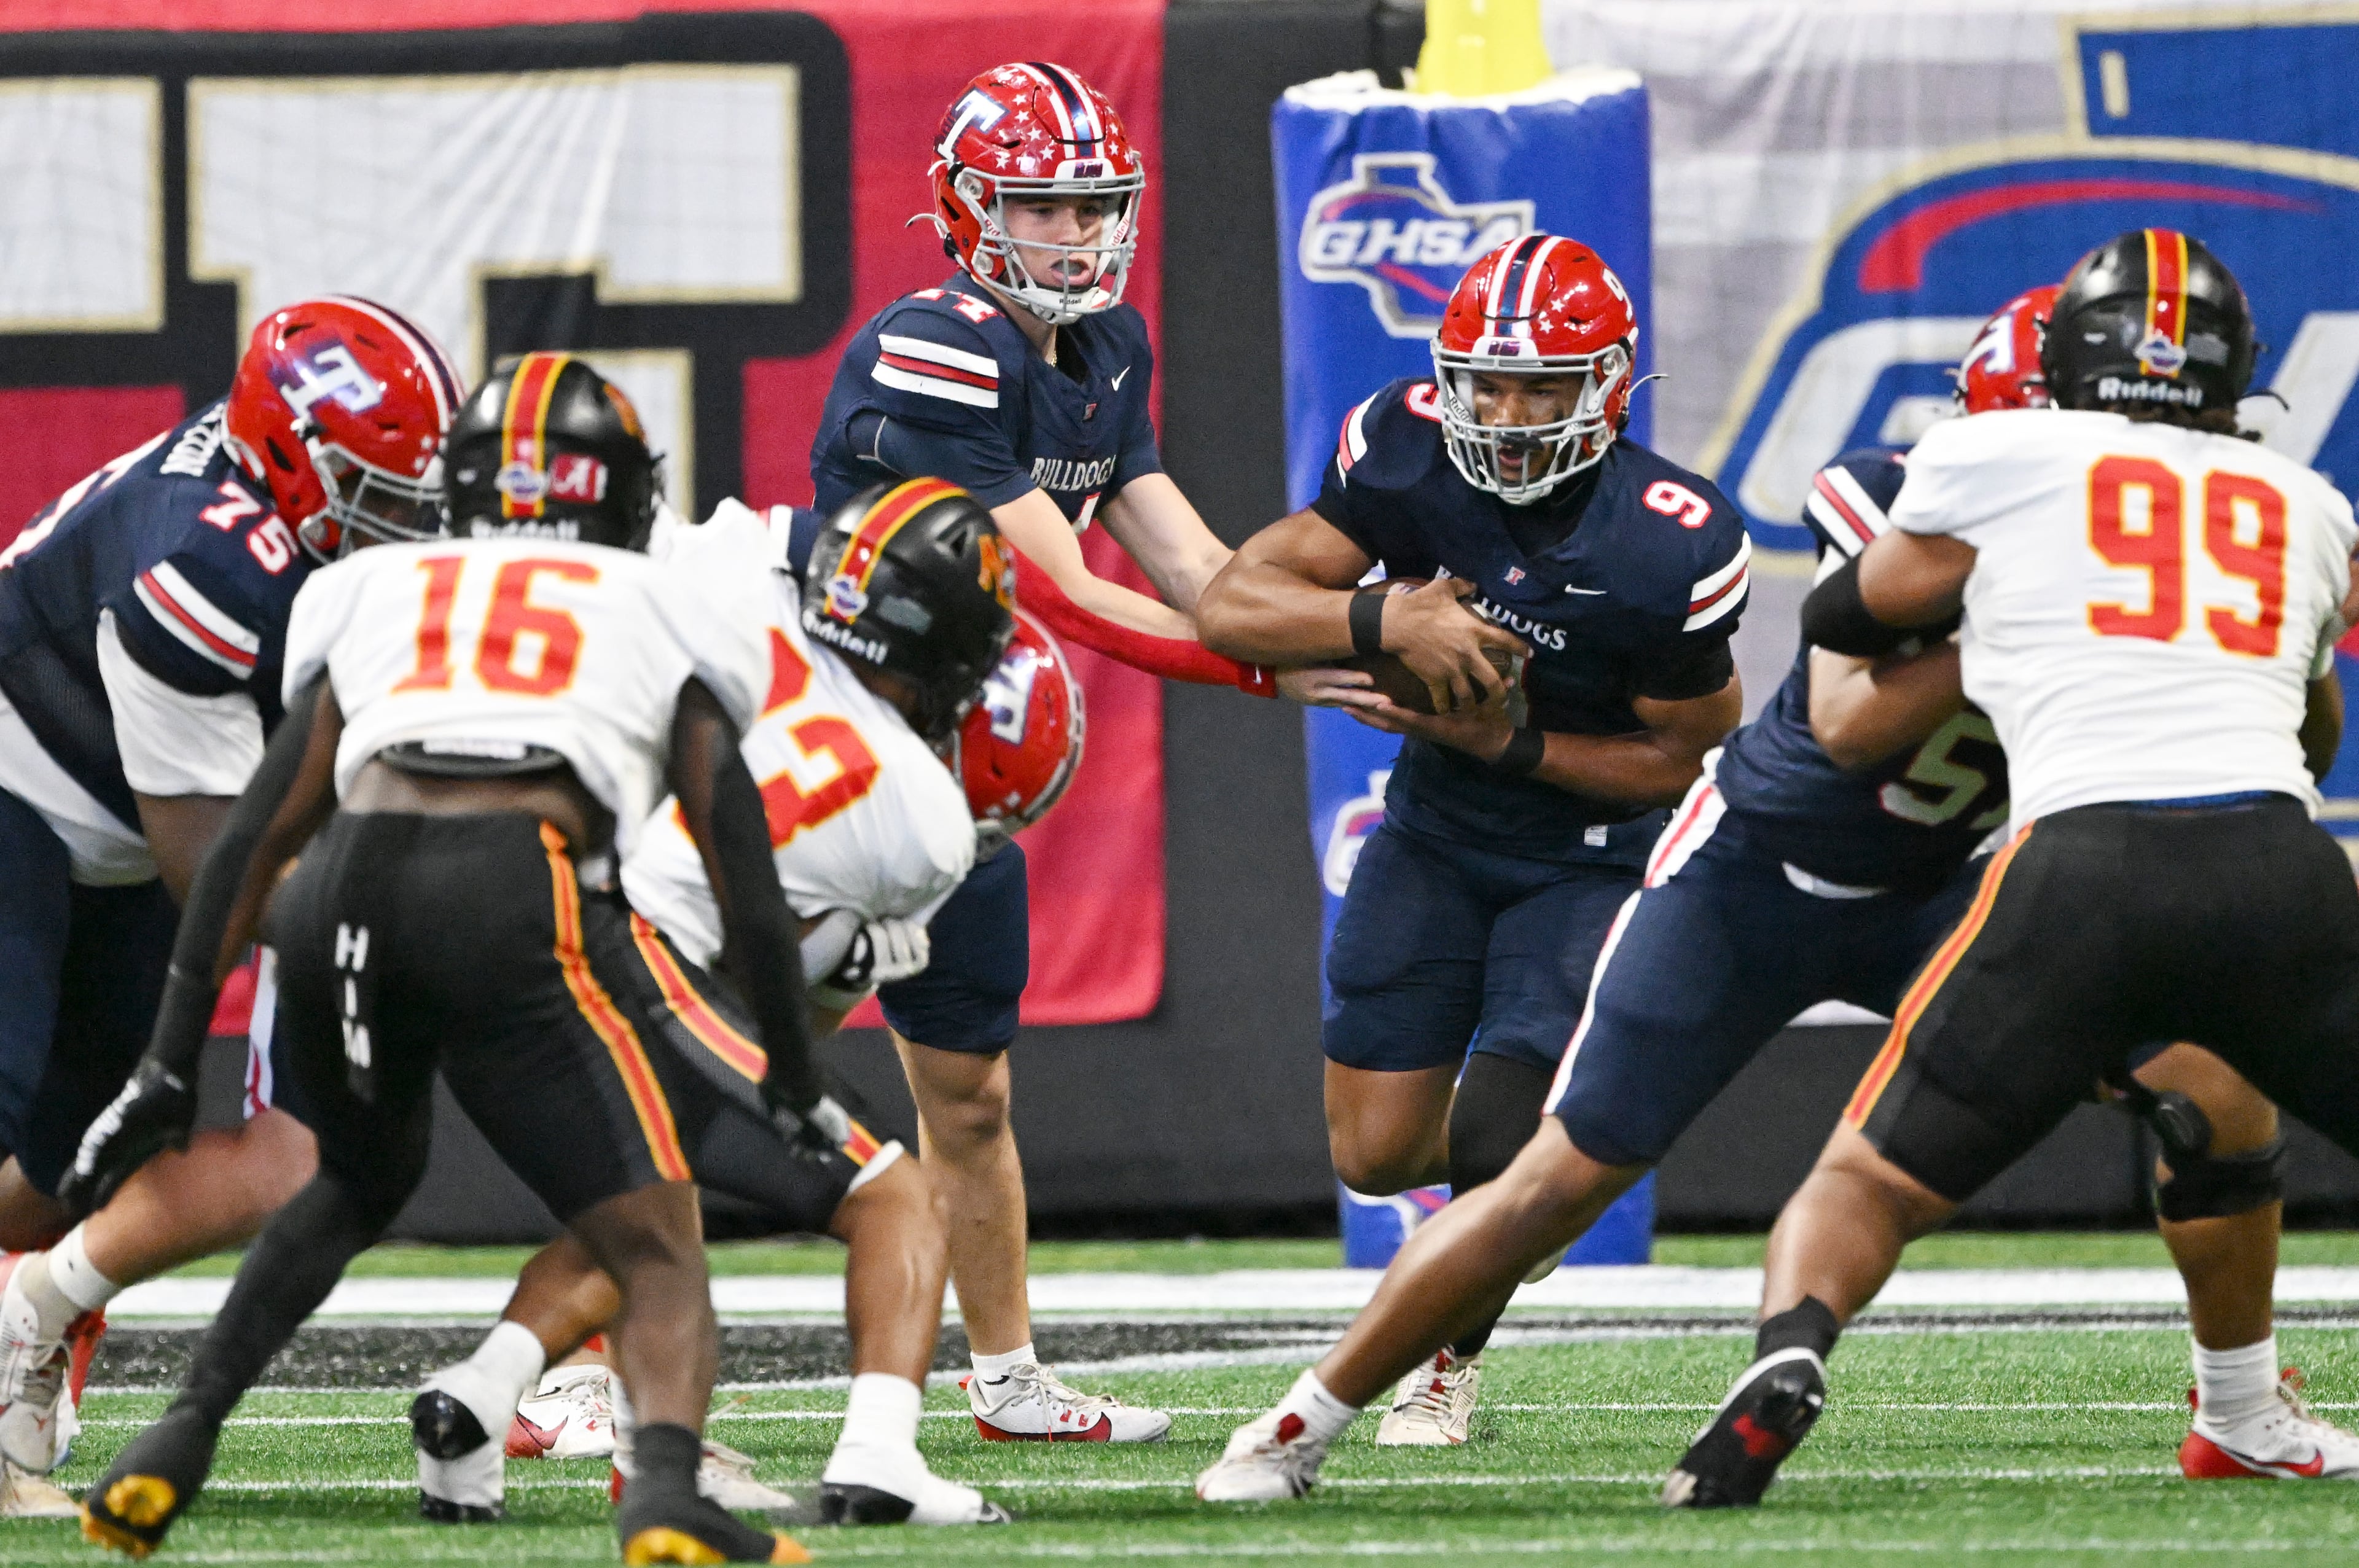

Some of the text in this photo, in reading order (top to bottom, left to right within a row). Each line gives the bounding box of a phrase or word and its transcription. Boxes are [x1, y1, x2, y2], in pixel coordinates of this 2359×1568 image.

[199, 480, 300, 576] 75
[1642, 480, 1712, 529] 9
[2087, 454, 2287, 657] 99
[390, 555, 601, 698] 16
[1879, 712, 2008, 830] 5
